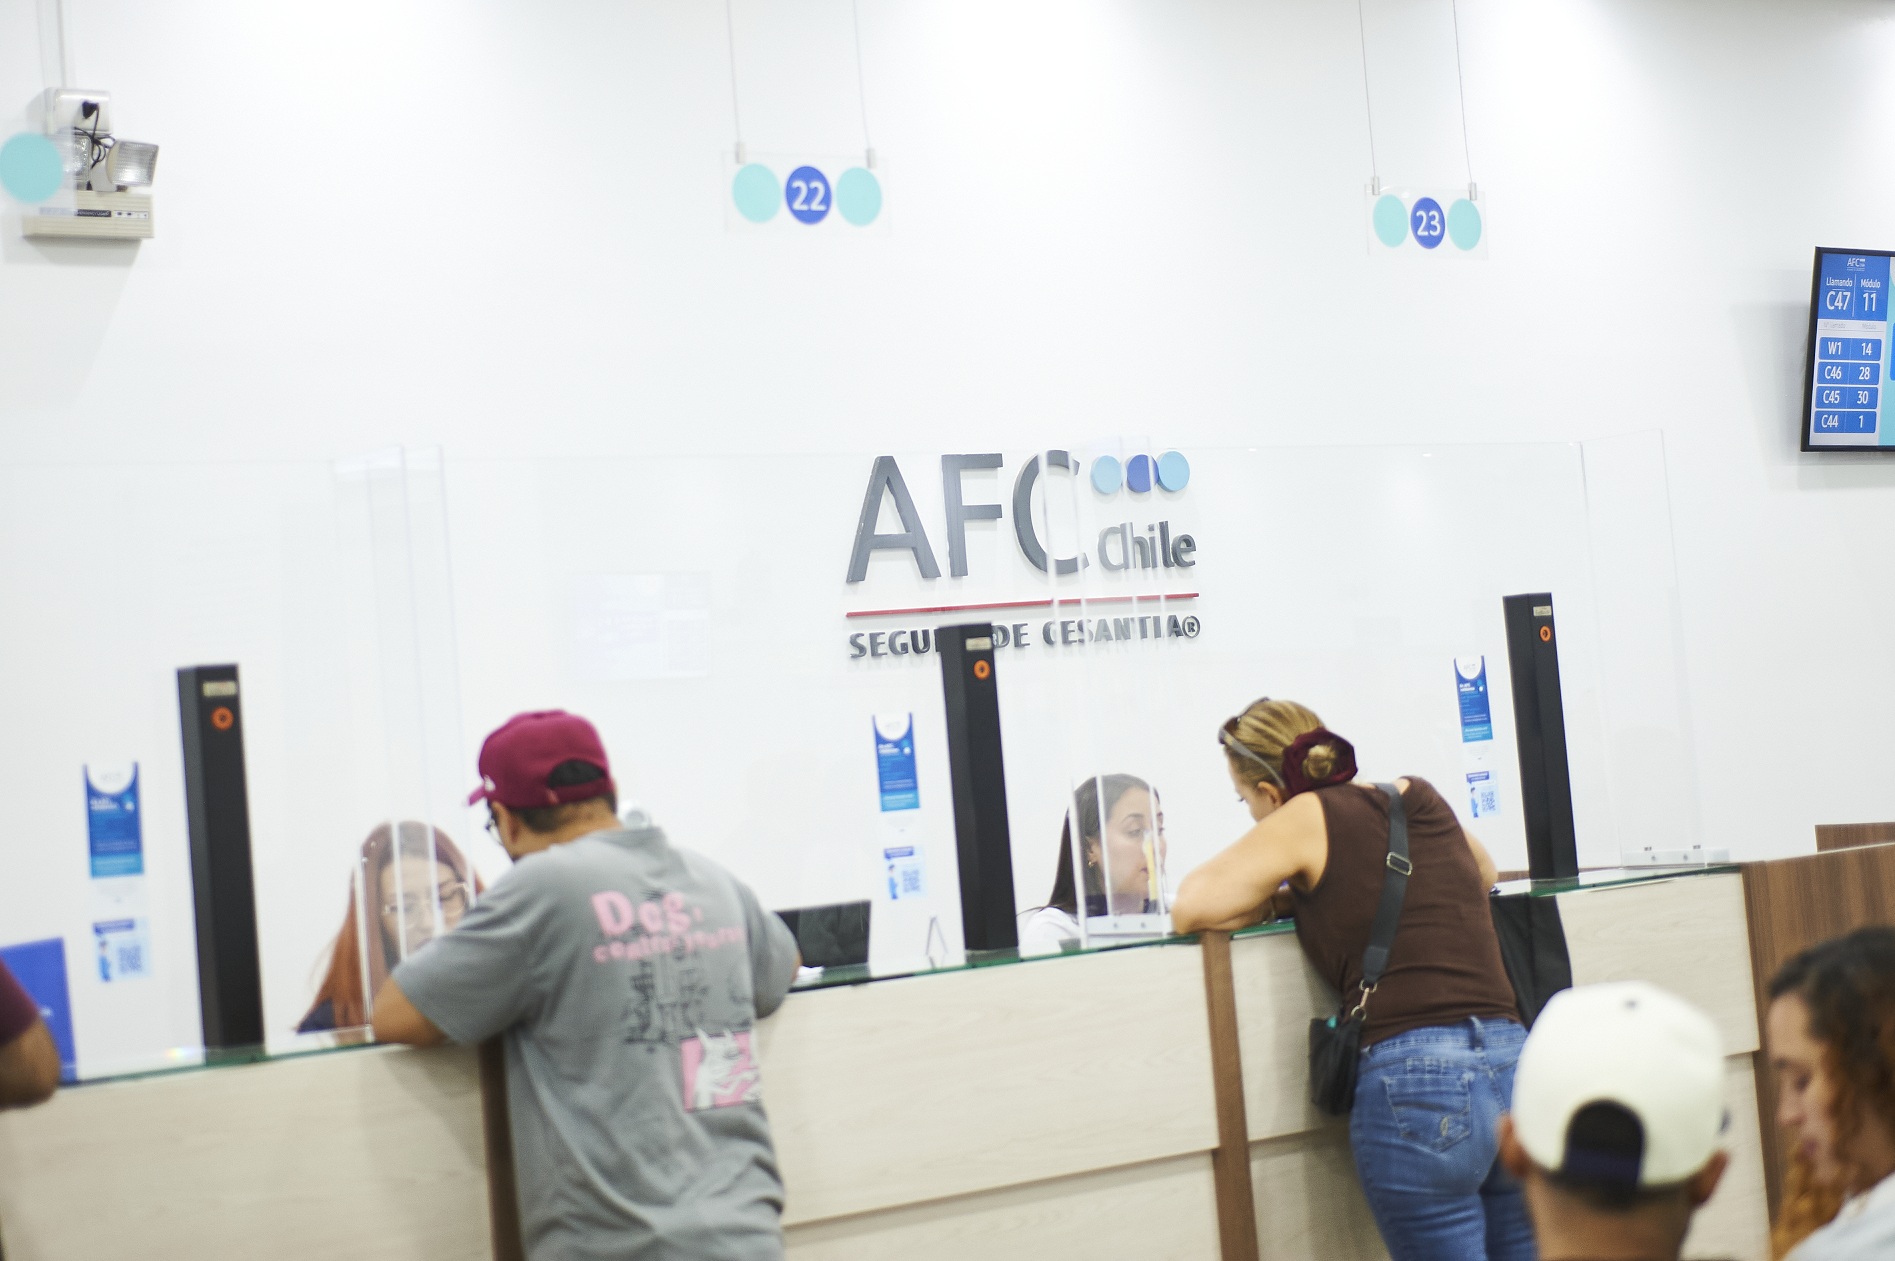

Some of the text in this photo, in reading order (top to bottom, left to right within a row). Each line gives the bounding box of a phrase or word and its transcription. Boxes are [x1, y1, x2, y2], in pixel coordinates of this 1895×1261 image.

[792, 181, 827, 211] 22
[1416, 211, 1441, 236] 23
[1826, 277, 1881, 289] Llamando Módulo
[1826, 291, 1877, 311] C47 11
[1828, 342, 1872, 356] W1 14
[1825, 366, 1870, 380] C46 28
[1823, 390, 1869, 404] C45 30
[1821, 415, 1864, 428] C44 1
[846, 450, 1090, 583] AFC
[1098, 521, 1197, 571] Chile
[850, 629, 940, 658] SEGU
[992, 623, 1030, 649] DE
